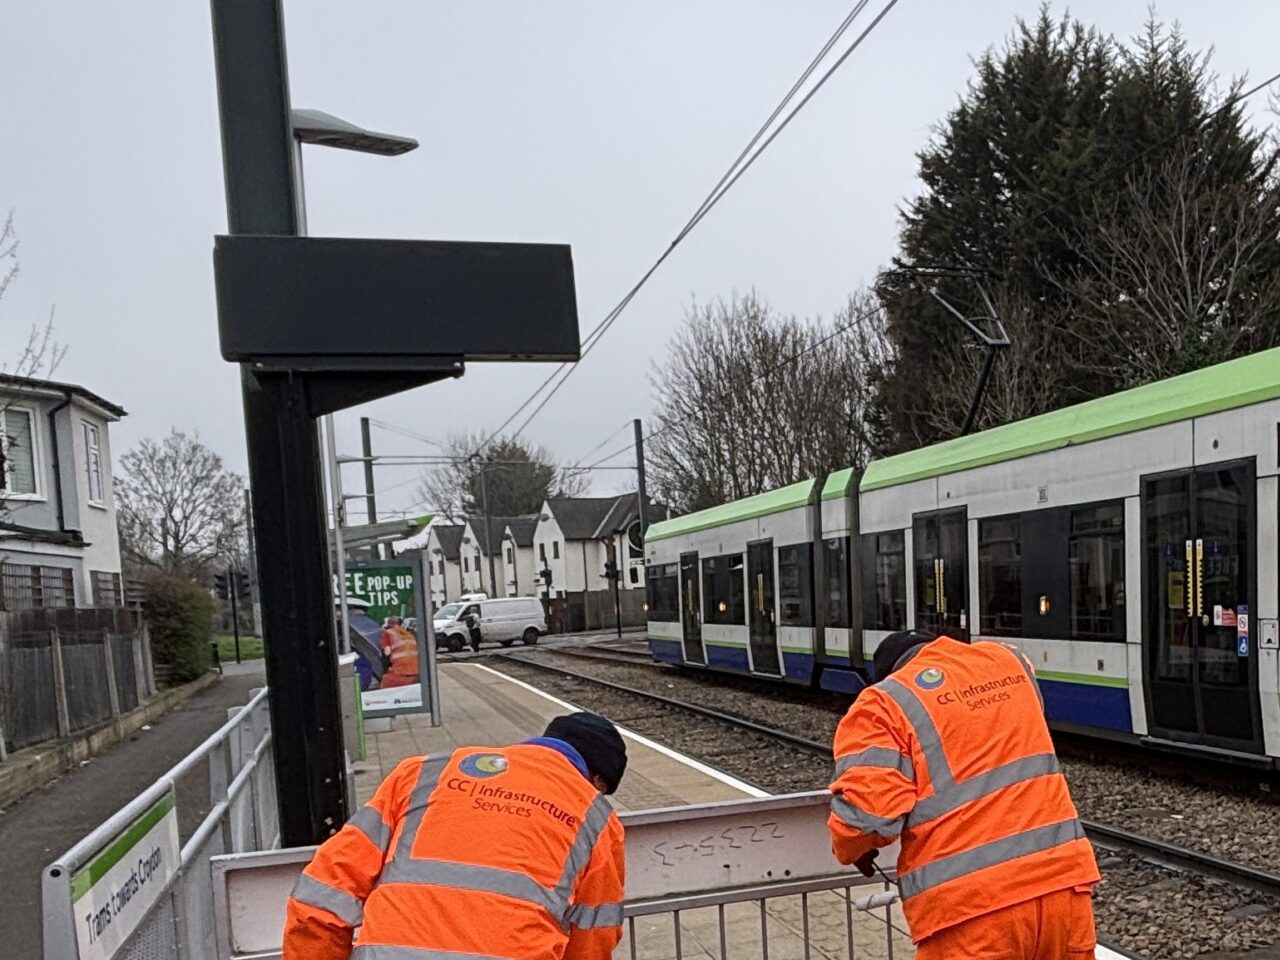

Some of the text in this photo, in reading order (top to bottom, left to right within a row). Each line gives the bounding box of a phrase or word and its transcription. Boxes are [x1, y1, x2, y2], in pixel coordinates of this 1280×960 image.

[366, 575, 413, 591] POP-UP
[368, 591, 399, 606] TIPS
[936, 674, 1026, 705] CC Infrastructure
[966, 691, 1011, 711] Services
[447, 778, 577, 828] CC Infrastructure
[472, 797, 532, 818] Services
[86, 902, 111, 944] Trams
[111, 868, 138, 915] towards
